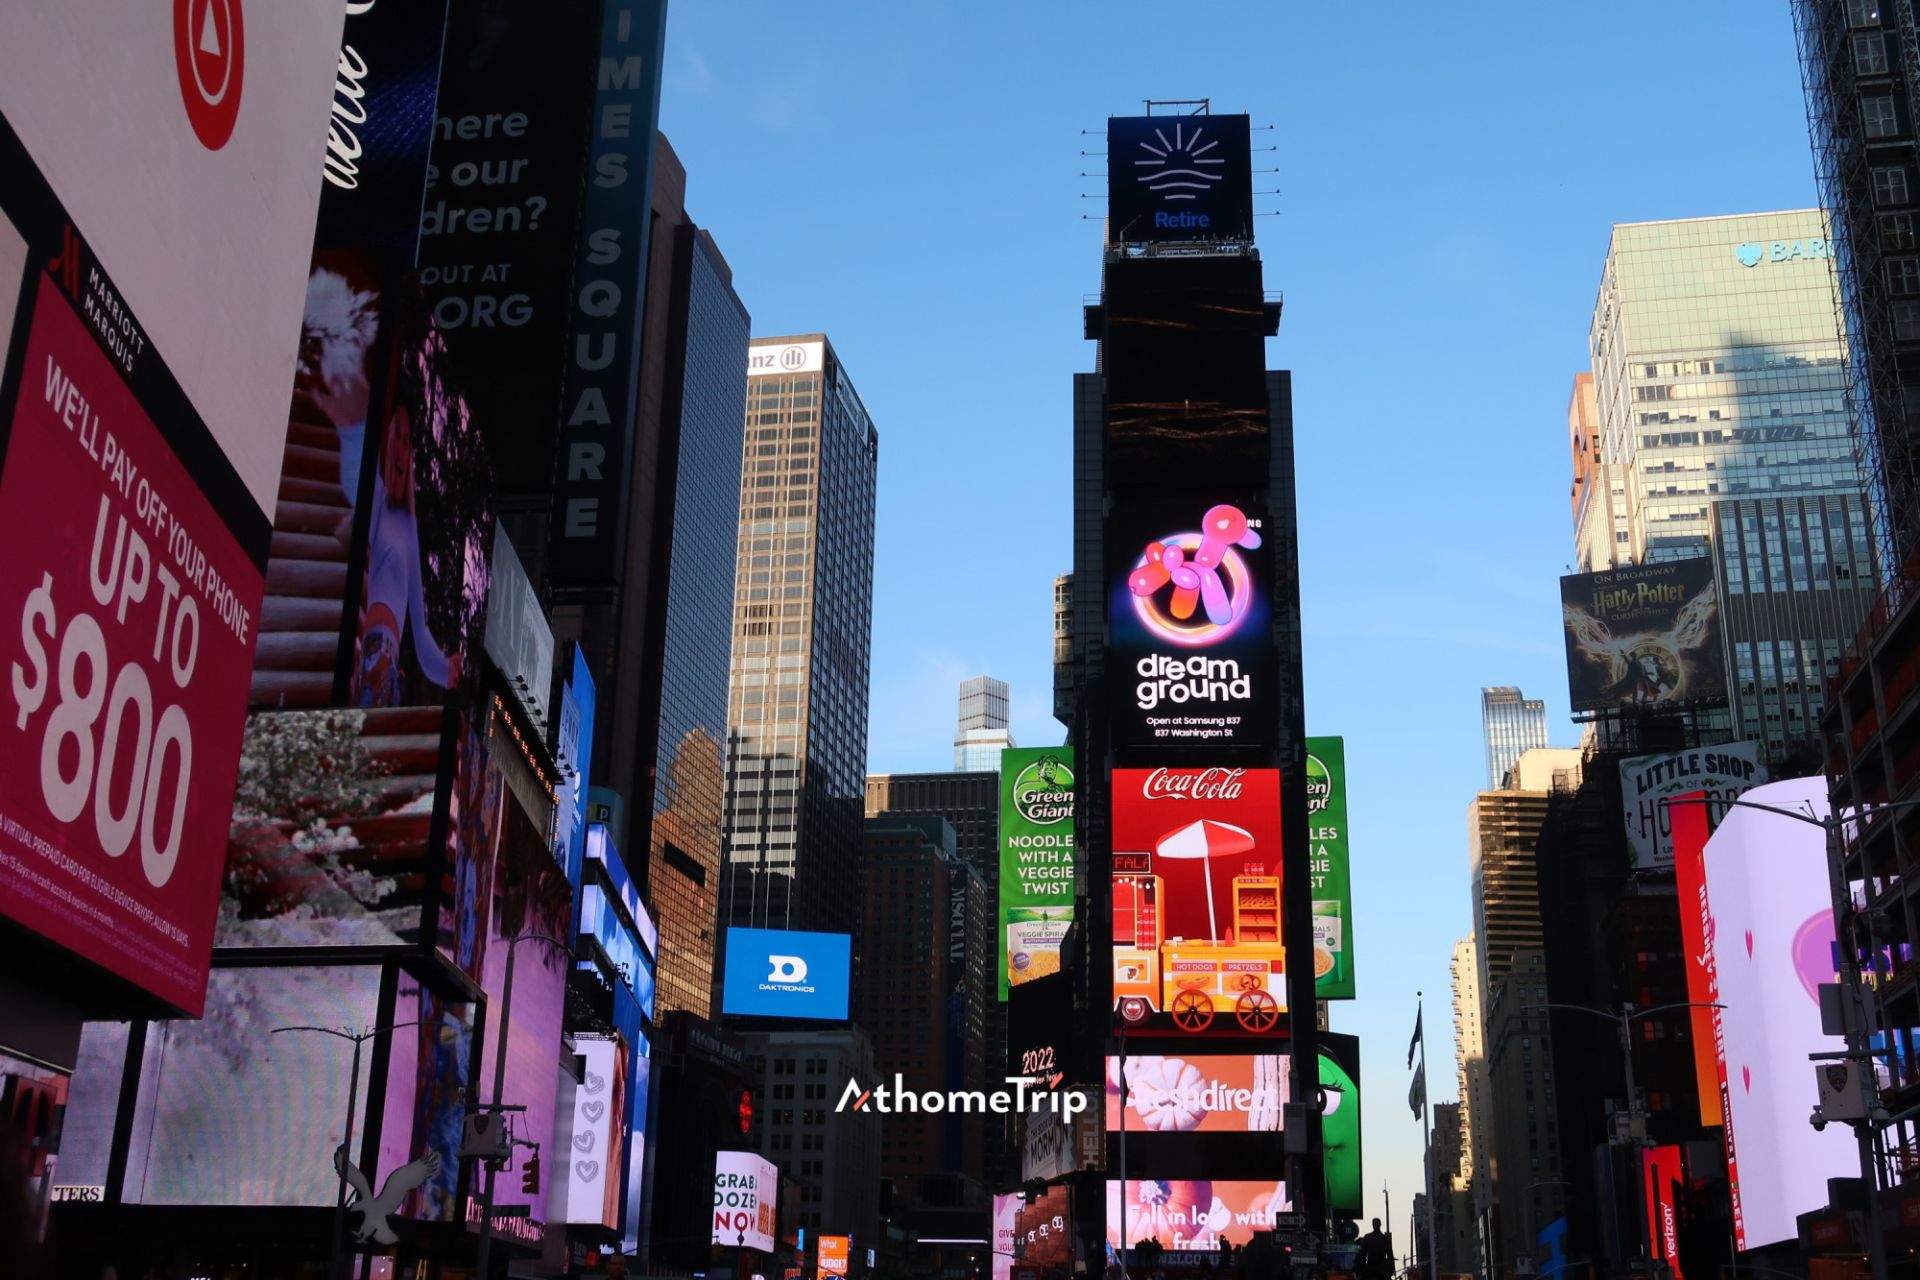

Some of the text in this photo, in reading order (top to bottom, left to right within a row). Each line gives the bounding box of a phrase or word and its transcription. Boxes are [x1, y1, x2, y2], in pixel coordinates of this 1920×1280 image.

[451, 157, 529, 187] our
[1155, 211, 1210, 228] Retire
[420, 264, 512, 286] OUT AT
[89, 267, 144, 355] MARRIOTT
[433, 293, 535, 331] ORG
[84, 293, 134, 373] MARQUIS
[748, 354, 775, 369] nz
[564, 228, 623, 539] SQUARE
[45, 354, 250, 646] WE'LL PAY OFF YOUR PHONE
[1594, 566, 1677, 584] ON BROADWAY
[90, 493, 200, 688] UP TO
[1590, 582, 1686, 618] Harry Potter
[1136, 654, 1239, 682] dream
[1136, 675, 1251, 710] ground
[12, 570, 193, 889] $800
[1146, 716, 1241, 728] Open at Samsung 837
[1155, 728, 1233, 740] 837 Washington St
[1636, 753, 1755, 795] LITTLE SHOP
[1021, 789, 1074, 804] Green
[1027, 804, 1074, 819] Giant
[1008, 834, 1074, 849] NOODLE
[1317, 843, 1328, 856] A
[32, 834, 61, 868] PREPAID
[60, 852, 79, 877] CARD
[78, 864, 91, 886] FOR
[1018, 850, 1073, 864] WITH A
[1017, 865, 1074, 880] VEGGIE
[1022, 881, 1070, 896] TWIST
[1017, 930, 1044, 938] VEGGIE
[1176, 963, 1214, 971] HOT DOGS
[1228, 963, 1264, 971] PRETZELS
[759, 984, 816, 993] DAKTRONICS
[1022, 1046, 1055, 1075] 2022
[715, 1173, 754, 1189] GRAB
[714, 1192, 757, 1209] DOZE
[1169, 1205, 1186, 1225] in
[1235, 1205, 1277, 1226] with
[1661, 1205, 1677, 1258] verizon
[1172, 1232, 1221, 1250] fresh
